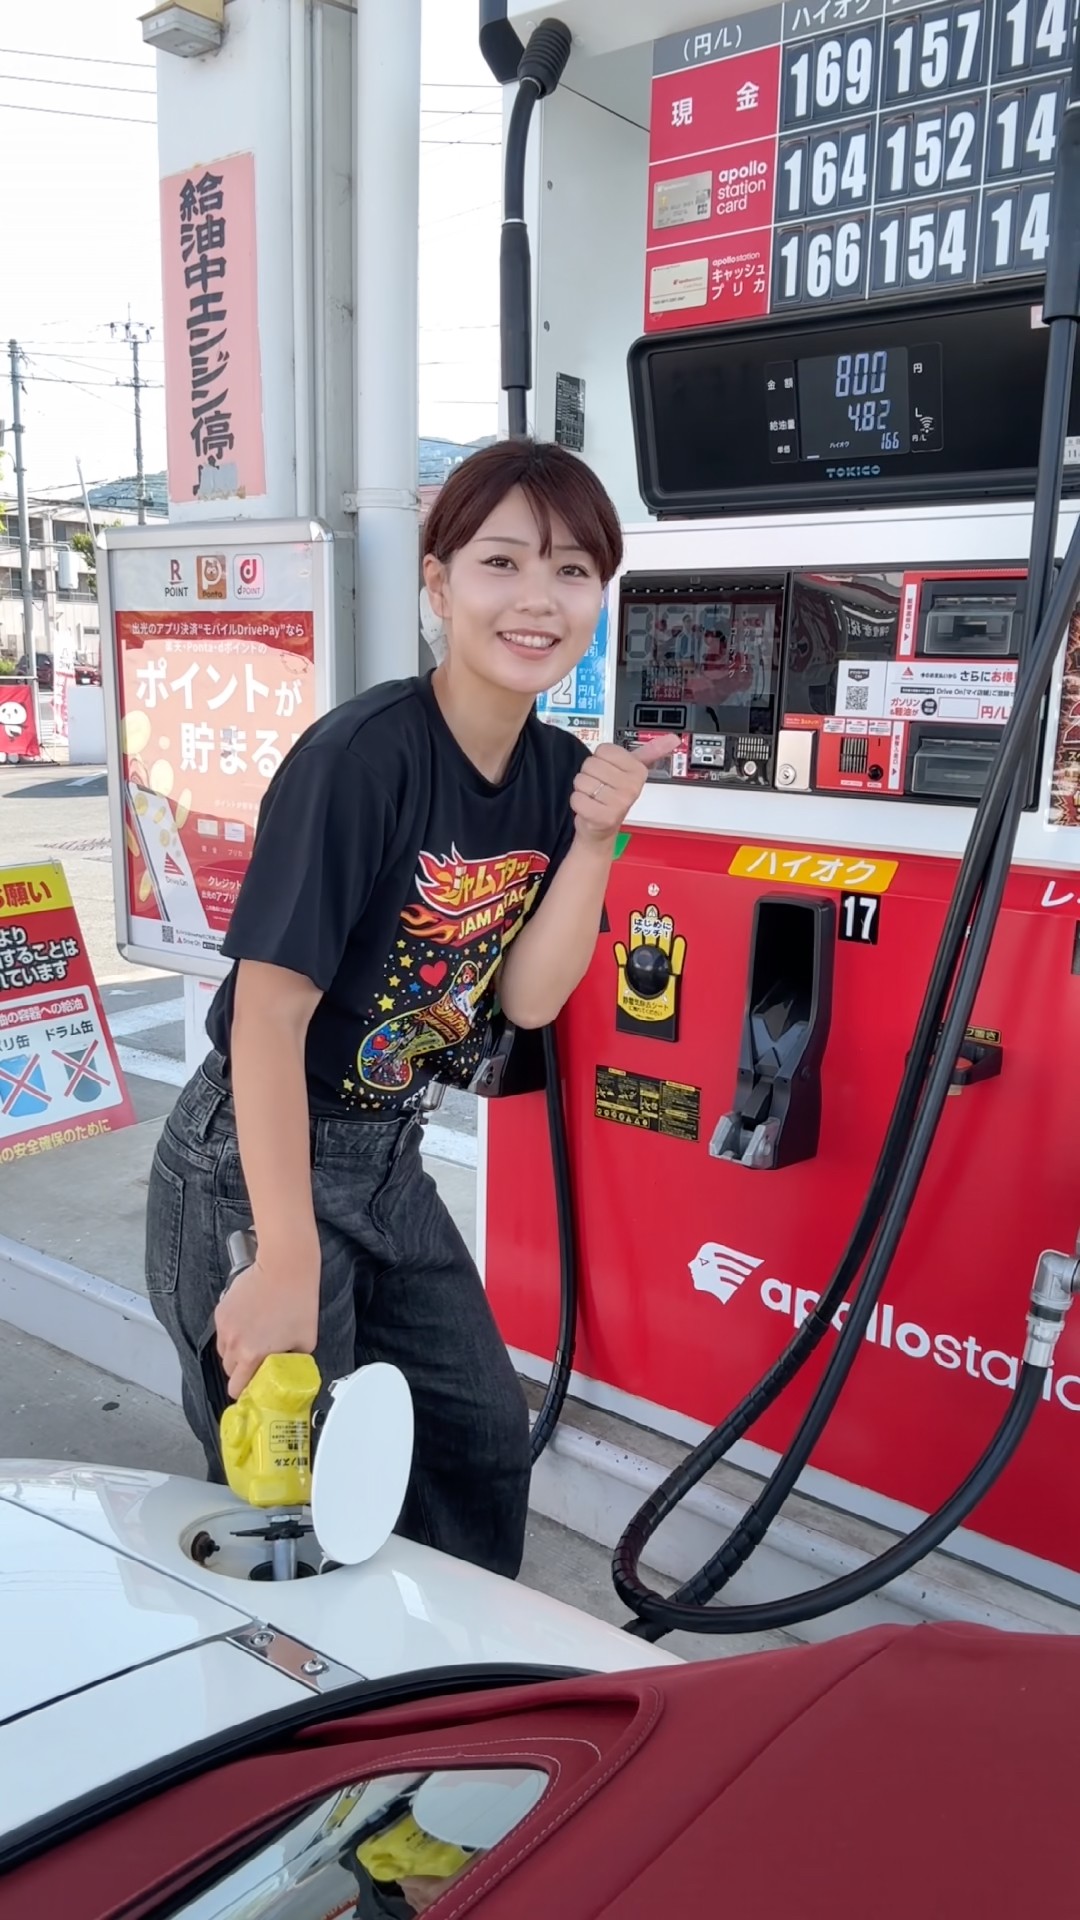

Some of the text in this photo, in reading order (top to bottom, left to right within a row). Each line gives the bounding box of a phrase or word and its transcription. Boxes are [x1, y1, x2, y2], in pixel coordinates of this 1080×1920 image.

[684, 25, 742, 61] (円/L)
[791, 0, 1079, 117] 169 157 14
[672, 81, 759, 127] 現金
[785, 92, 1058, 211] 164 152 14
[718, 160, 767, 184] apollo
[717, 179, 766, 200] station
[716, 195, 748, 215] card
[782, 192, 1050, 297] 166 154 14
[712, 251, 760, 268] apollostation
[712, 264, 765, 283] キャッシュ
[712, 278, 765, 300] プリカ
[835, 351, 888, 397] 800
[913, 362, 923, 374] 円
[848, 400, 890, 432] 4.82
[915, 407, 923, 418] L
[881, 431, 900, 450] 166
[826, 464, 881, 478] TOKICO
[165, 587, 189, 597] POINT
[202, 590, 223, 599] Ponta
[136, 657, 303, 717] ポイントが
[747, 851, 876, 884] ハイオク
[0, 880, 52, 908] 願い
[207, 875, 242, 890] クレジット
[428, 858, 534, 906] ジャムアタッ
[1041, 881, 1080, 908] レ
[202, 889, 239, 905] 出光のアプリ
[458, 886, 527, 940] JAM ATAC
[634, 918, 672, 931] はじめに
[844, 896, 877, 940] 17
[0, 938, 79, 970] することは
[0, 1034, 30, 1053] リ缶
[45, 1020, 94, 1042] ドラム缶
[0, 1118, 112, 1164] の安全確保のために
[760, 1277, 1080, 1412] apollostaio
